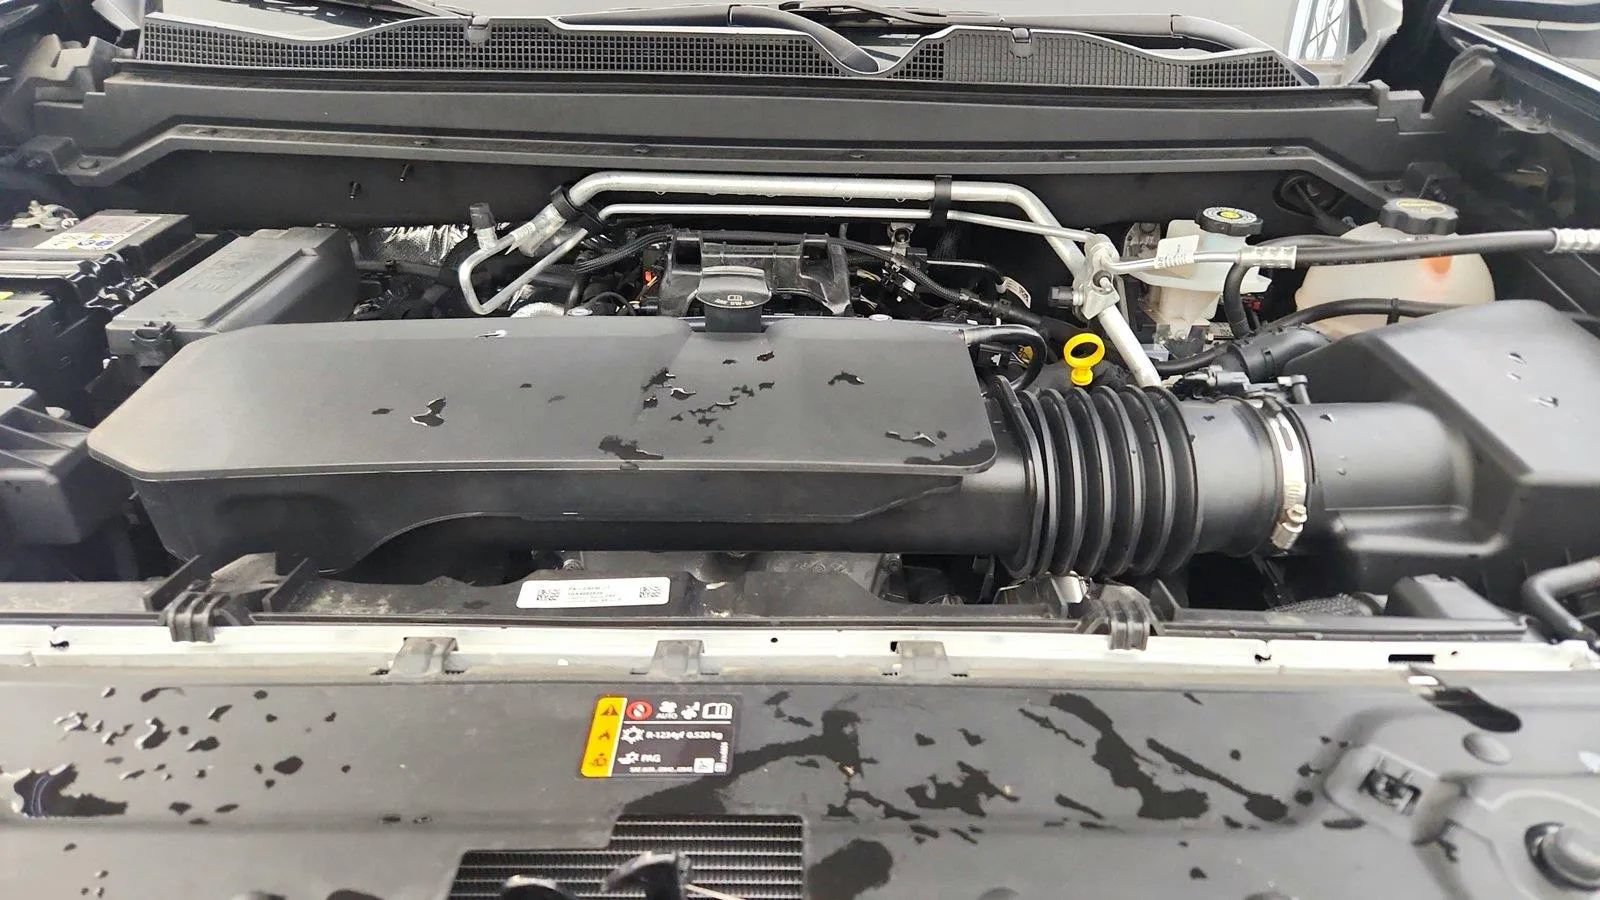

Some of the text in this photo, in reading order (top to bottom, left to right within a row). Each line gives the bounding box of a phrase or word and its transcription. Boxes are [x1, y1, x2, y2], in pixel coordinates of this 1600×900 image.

[656, 712, 678, 720] AUTO
[645, 731, 723, 741] R-1234yf 0.520 kg
[641, 754, 661, 763] PAG
